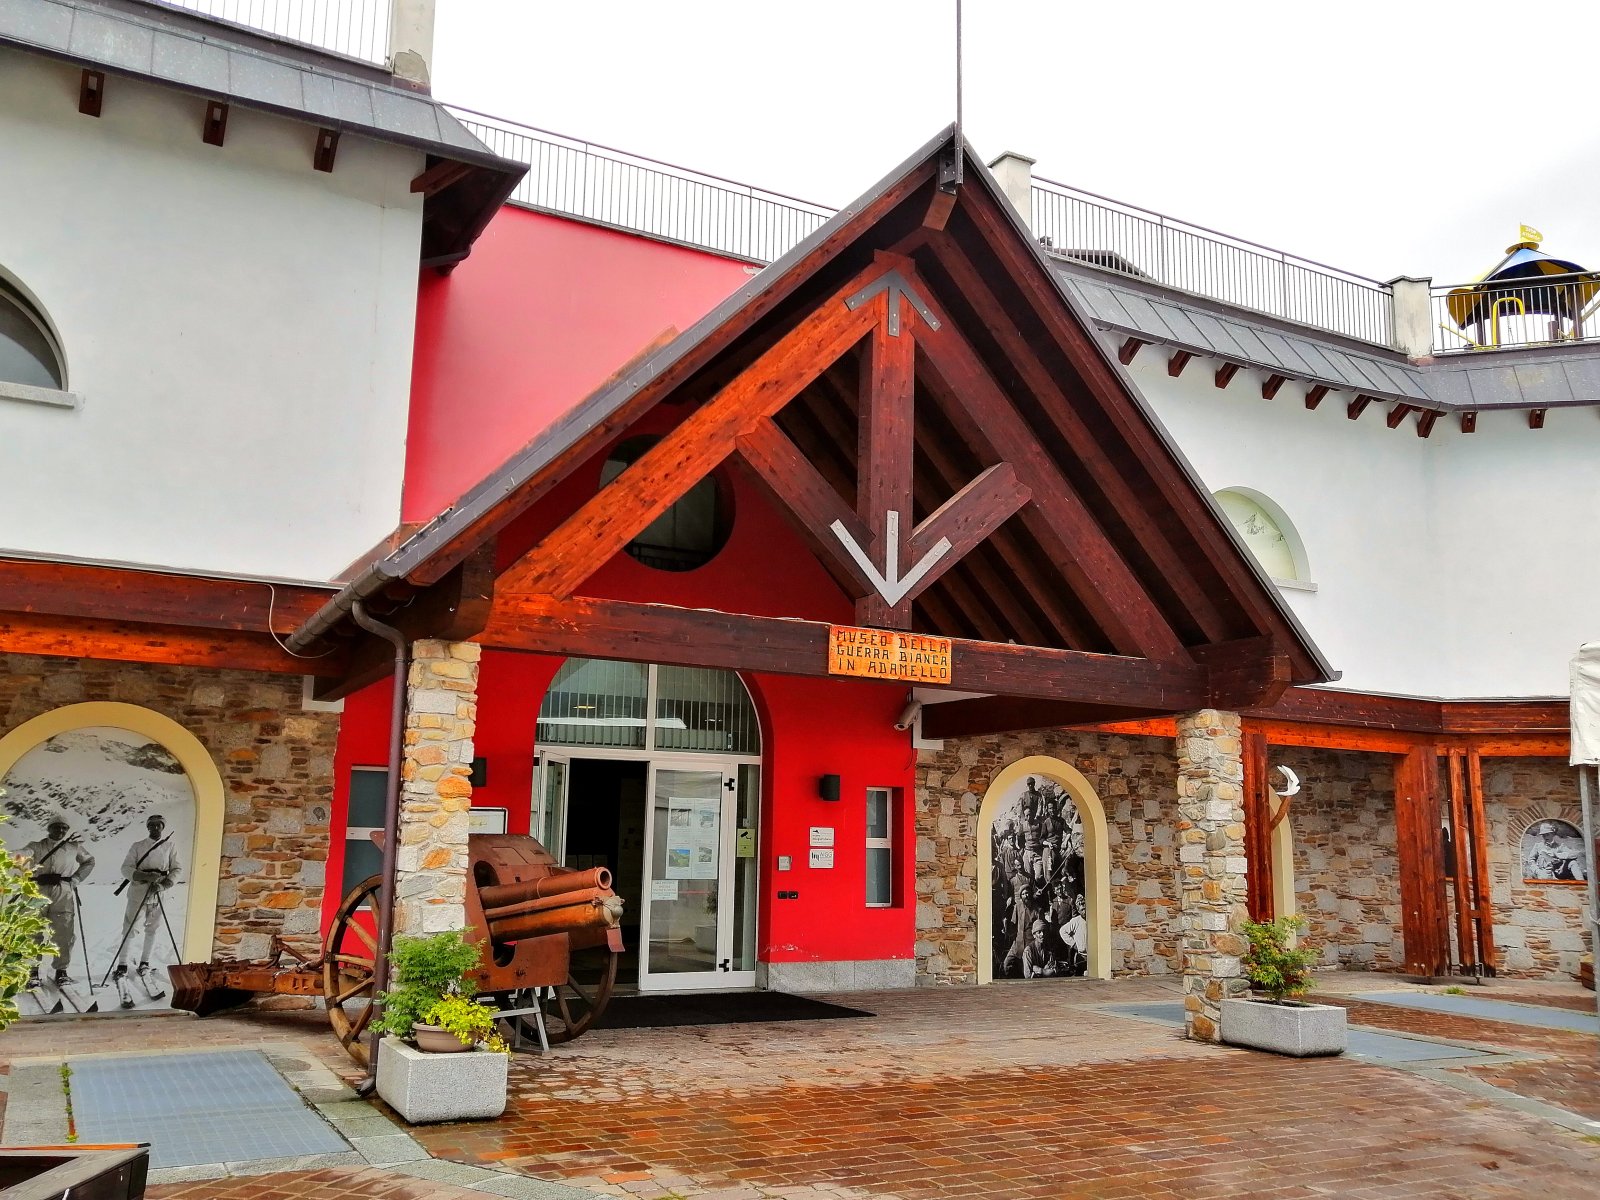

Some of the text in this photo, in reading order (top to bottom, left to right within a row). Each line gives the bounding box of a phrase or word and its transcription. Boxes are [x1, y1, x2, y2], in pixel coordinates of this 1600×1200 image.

[837, 645, 947, 666] GUERRA BIANCA
[899, 637, 948, 653] DELLA
[839, 657, 947, 679] IN ADAMELLO
